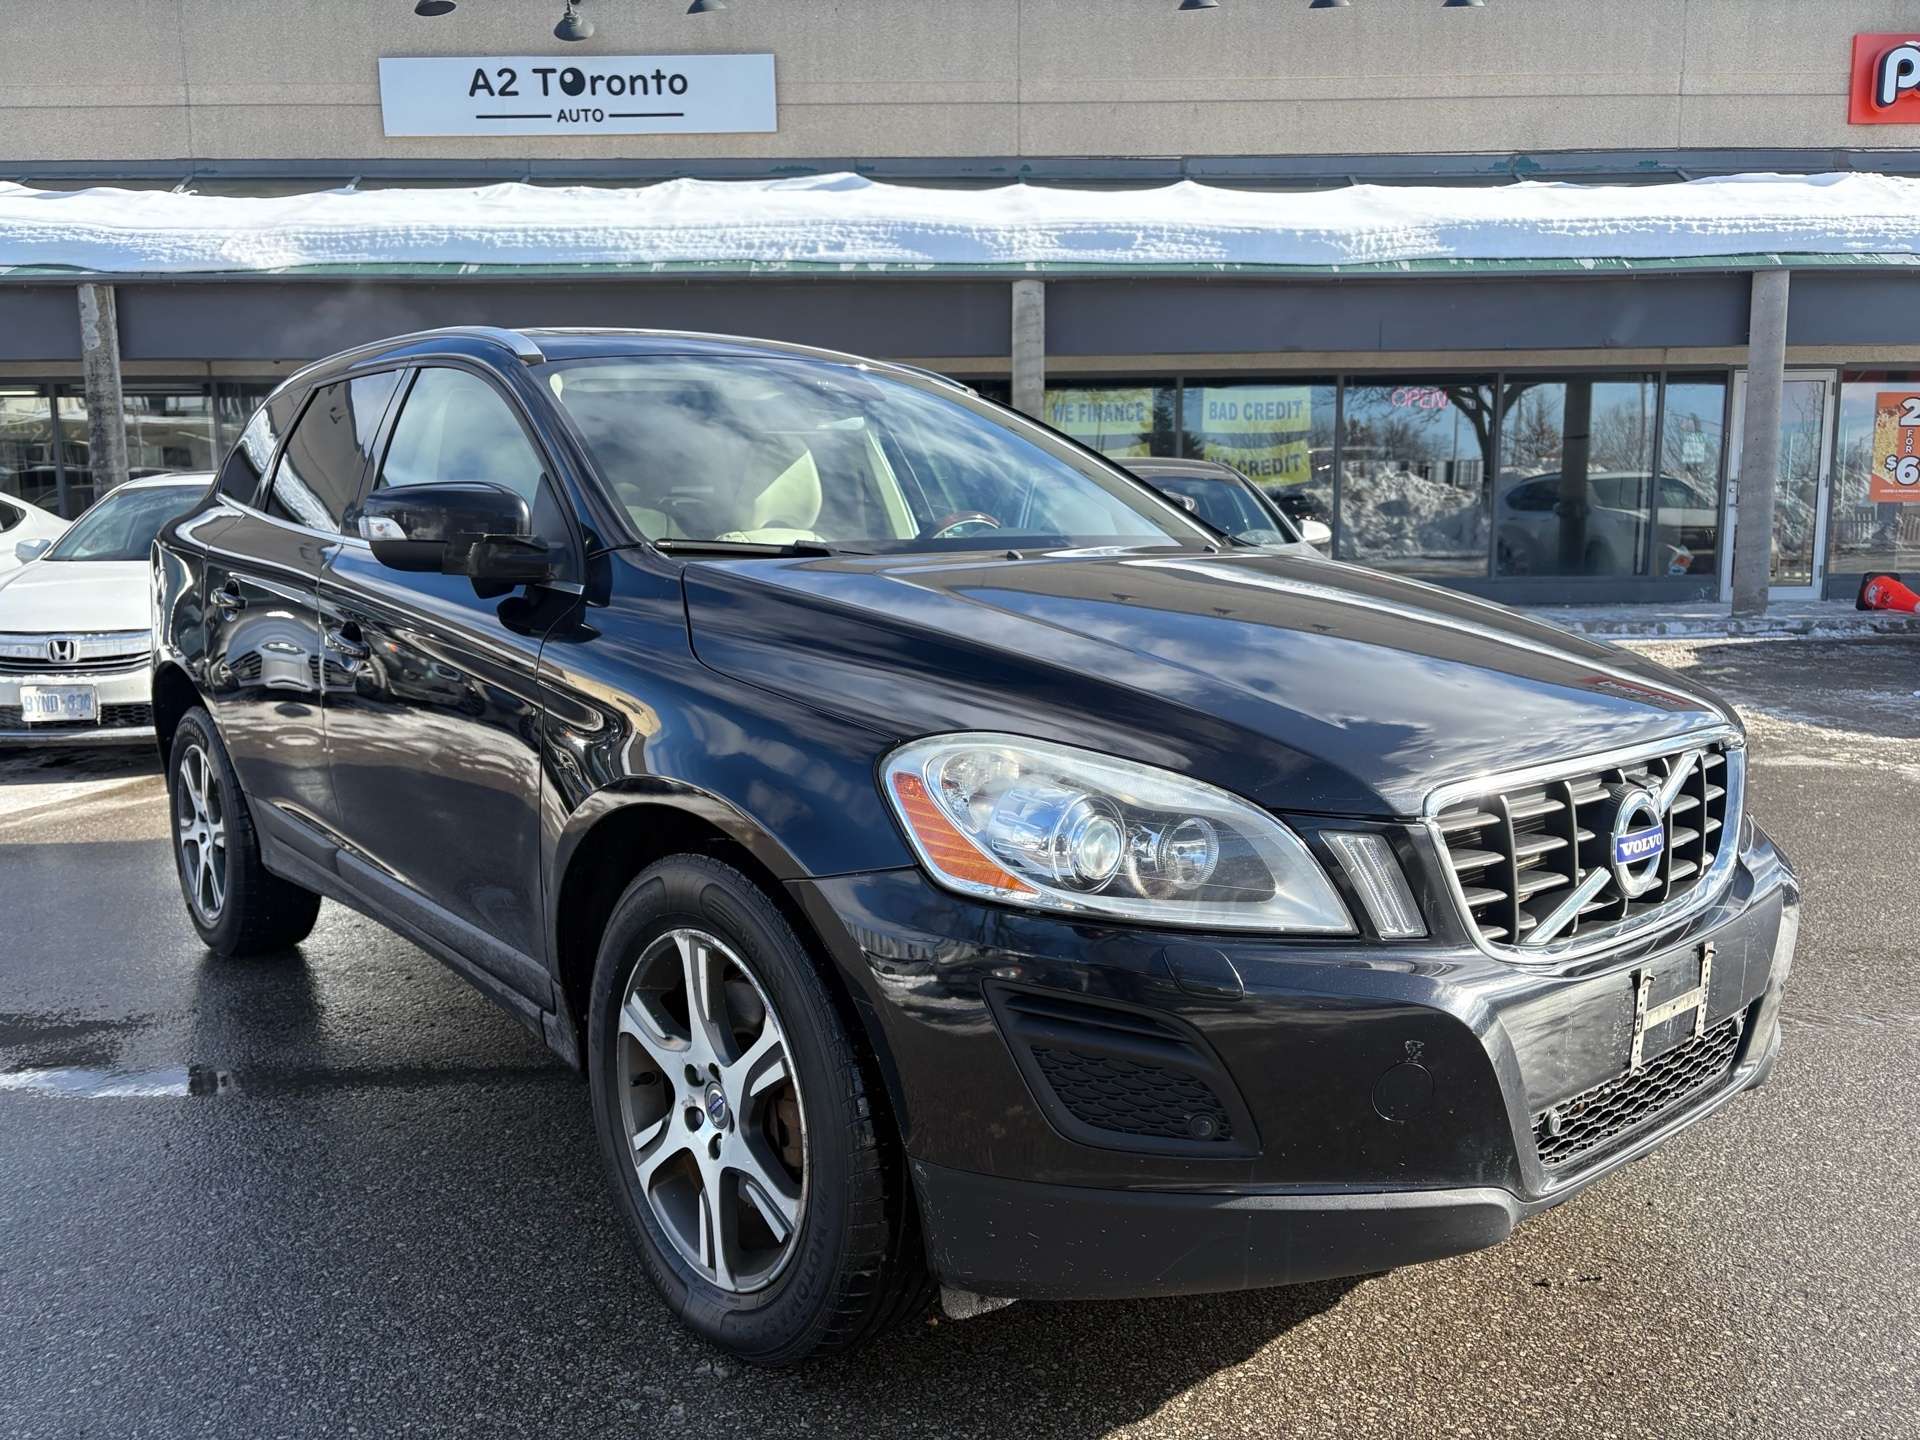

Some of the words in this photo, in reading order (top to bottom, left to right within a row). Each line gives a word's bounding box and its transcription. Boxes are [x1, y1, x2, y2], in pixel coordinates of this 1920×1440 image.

[469, 68, 519, 97] A2
[557, 109, 604, 123] AUTO
[1208, 401, 1238, 420] BAD
[1243, 400, 1302, 421] CREDIT
[1392, 389, 1448, 409] OPEN
[1053, 402, 1073, 421] WE
[1079, 401, 1144, 421] FINANCE
[1899, 397, 1920, 427] 2
[1905, 429, 1914, 454] FOR
[1239, 454, 1302, 477] CREDIT
[1619, 833, 1662, 856] VOLVO
